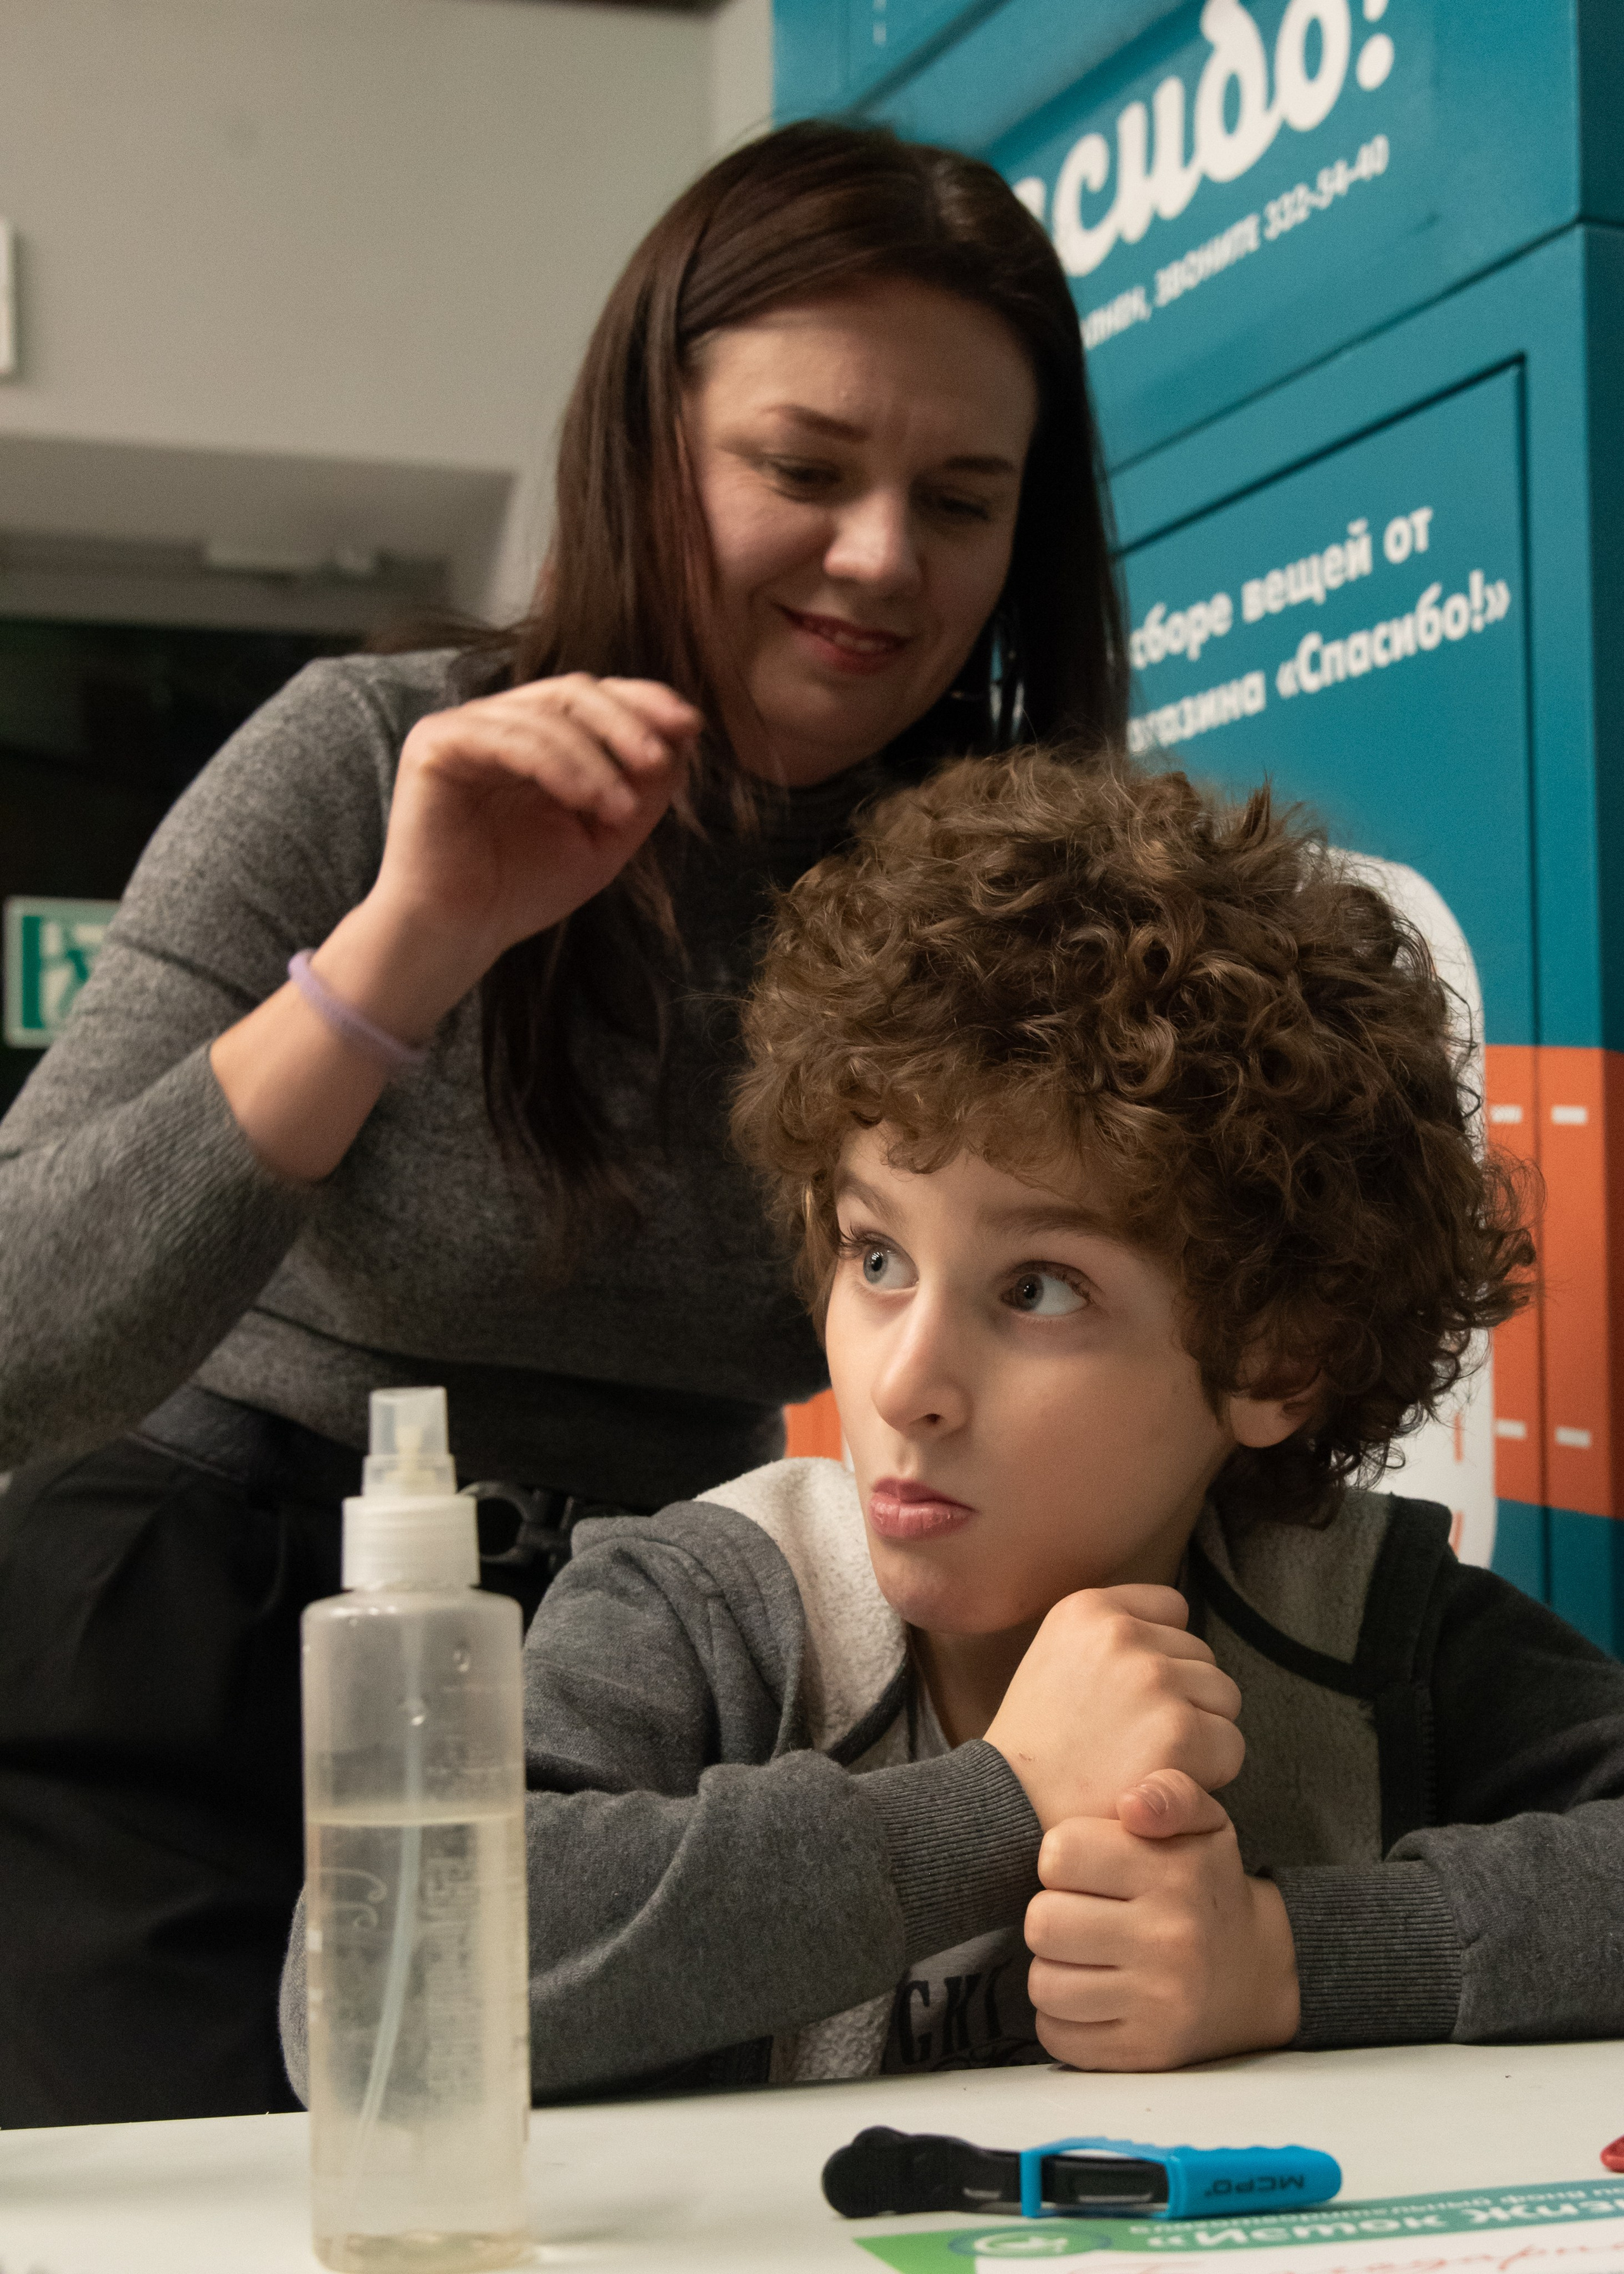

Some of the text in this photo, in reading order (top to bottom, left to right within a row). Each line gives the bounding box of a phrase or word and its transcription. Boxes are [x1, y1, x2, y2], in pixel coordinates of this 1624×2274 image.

[1013, 0, 1394, 277] сибо!
[1241, 518, 1373, 623] вещей
[1384, 507, 1432, 563] от
[1275, 569, 1510, 697] «Спасибо!»
